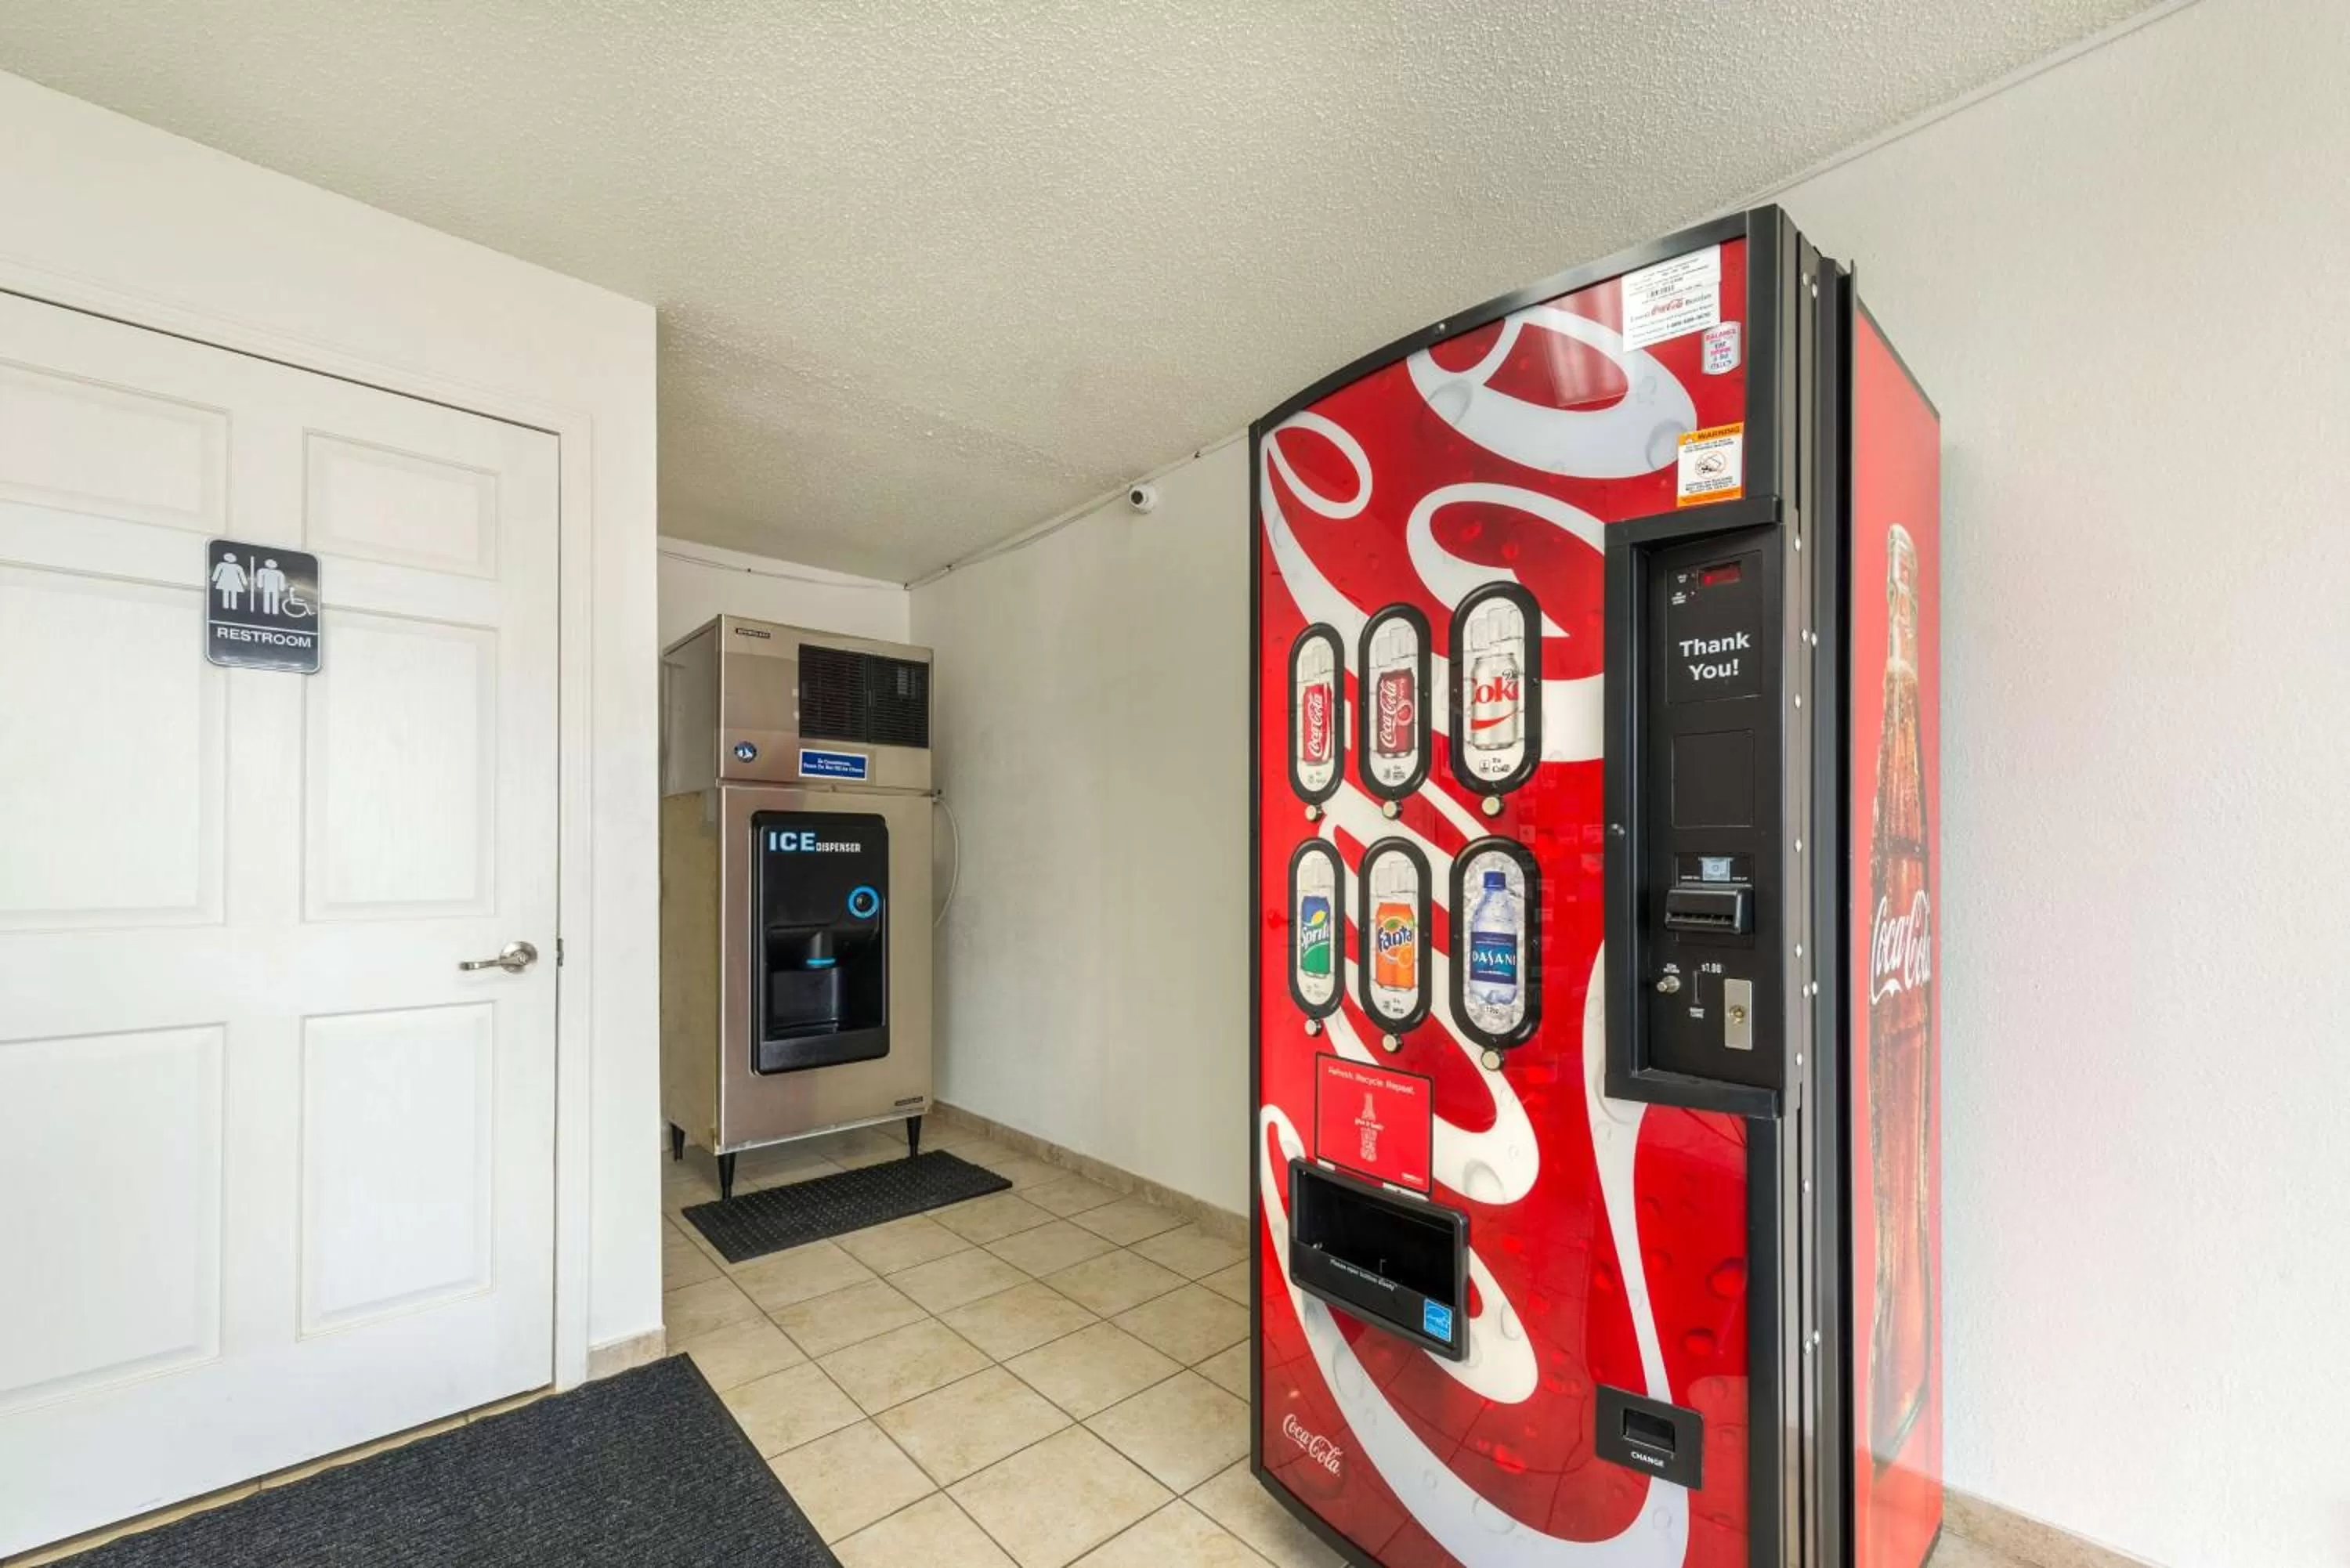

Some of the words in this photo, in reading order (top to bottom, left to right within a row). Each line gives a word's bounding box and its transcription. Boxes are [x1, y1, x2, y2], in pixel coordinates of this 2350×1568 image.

[1697, 425, 1741, 439] WARNING
[216, 627, 312, 649] RESTROOM
[1679, 631, 1752, 657] Thank
[1689, 659, 1740, 681] You!
[768, 831, 815, 851] ICE
[815, 841, 862, 853] DISPENSER
[1379, 925, 1413, 952] Fanta
[1471, 949, 1517, 966] DASANI
[1282, 1413, 1343, 1477] Coca-Cola
[1630, 1451, 1665, 1469] CHANGE
